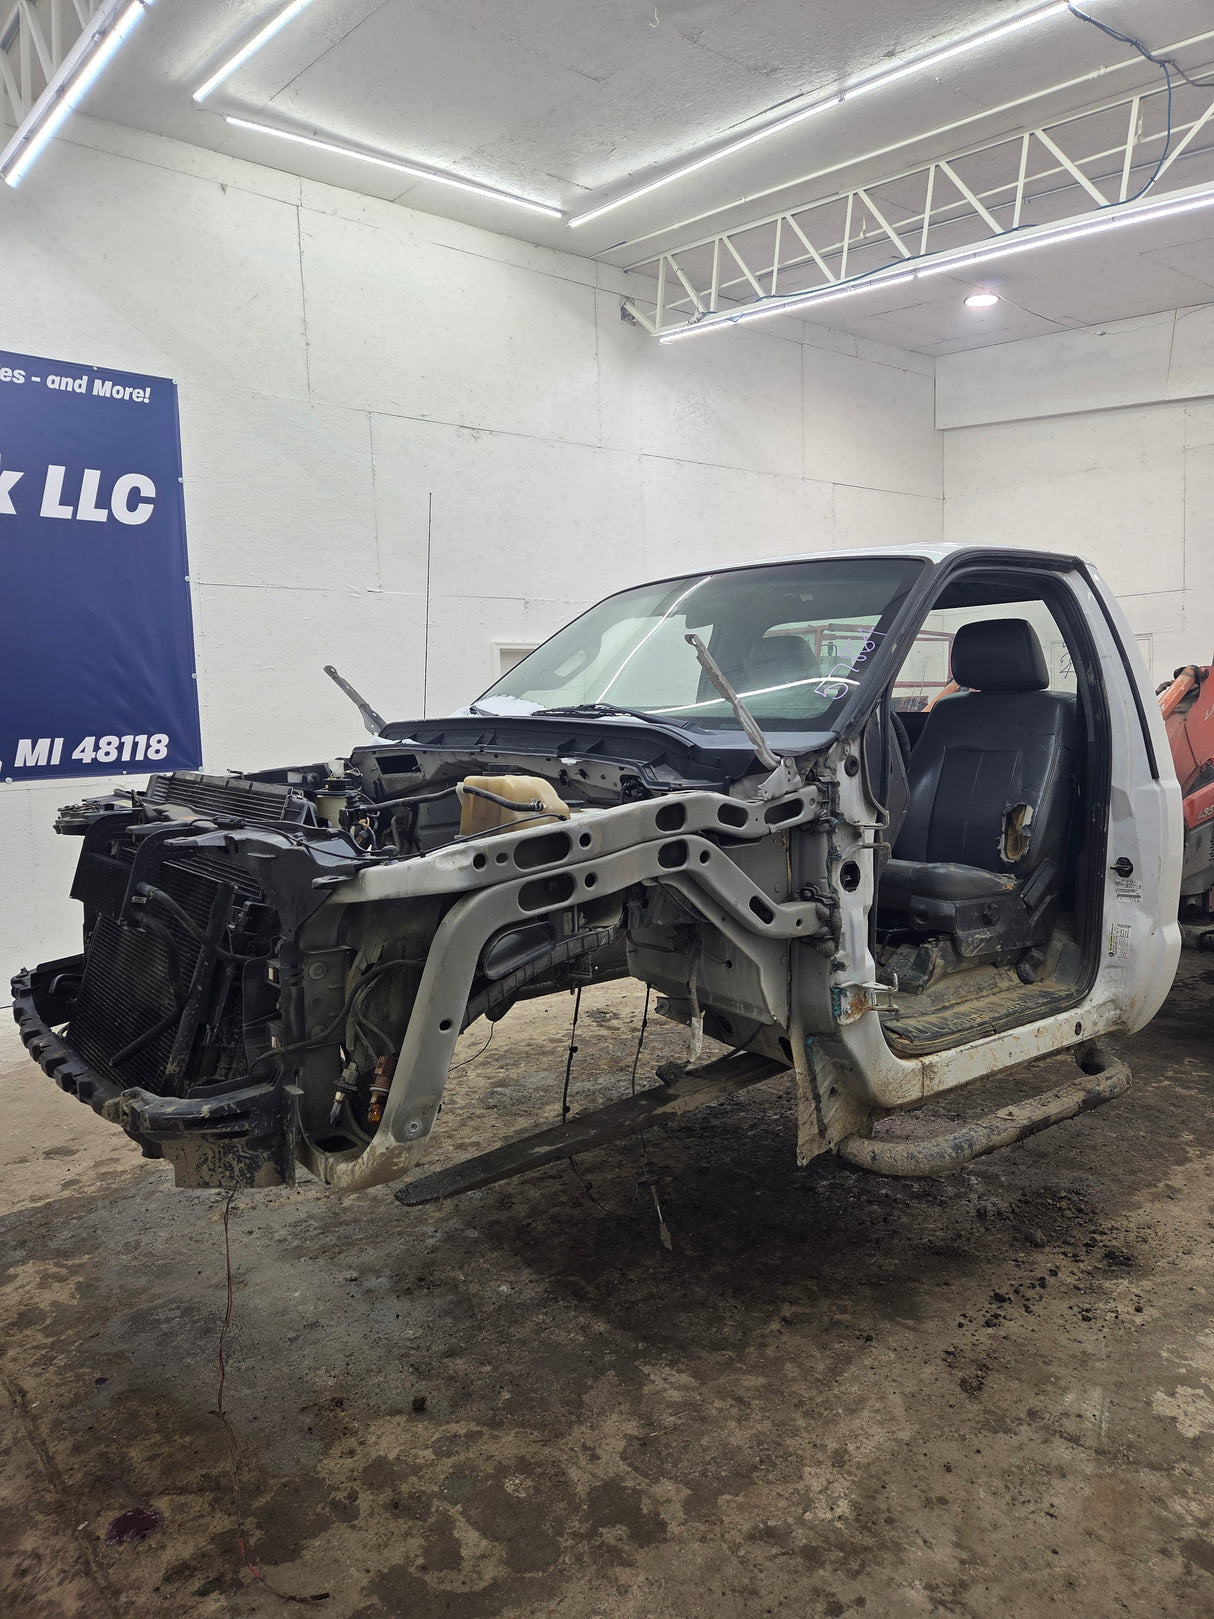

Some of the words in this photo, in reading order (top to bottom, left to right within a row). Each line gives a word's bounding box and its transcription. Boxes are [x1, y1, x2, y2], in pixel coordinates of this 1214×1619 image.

[47, 375, 88, 393] and
[92, 379, 151, 403] More!
[40, 464, 156, 525] LLC
[14, 737, 64, 768] MI
[71, 733, 169, 764] 48118
